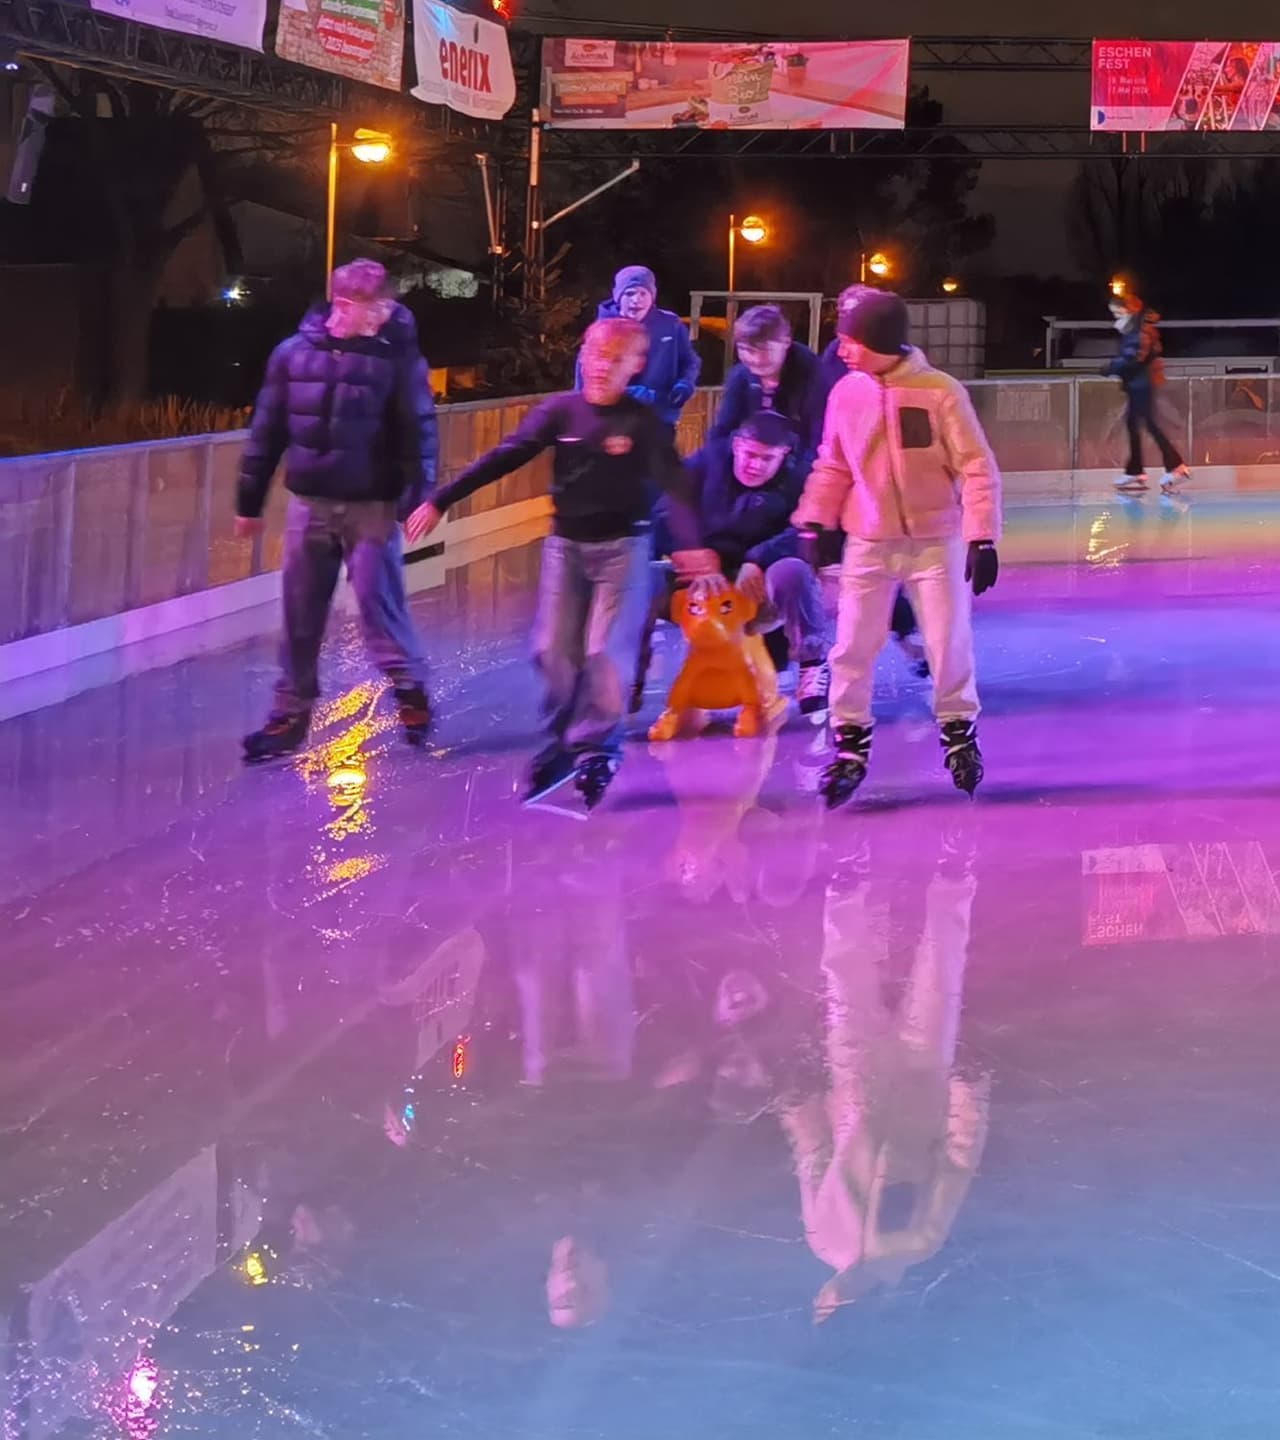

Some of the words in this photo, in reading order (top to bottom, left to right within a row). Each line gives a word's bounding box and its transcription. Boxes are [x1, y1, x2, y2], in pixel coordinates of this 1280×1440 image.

[1099, 47, 1152, 58] ESCHEN
[440, 37, 492, 93] enerix
[1099, 59, 1130, 69] FEST
